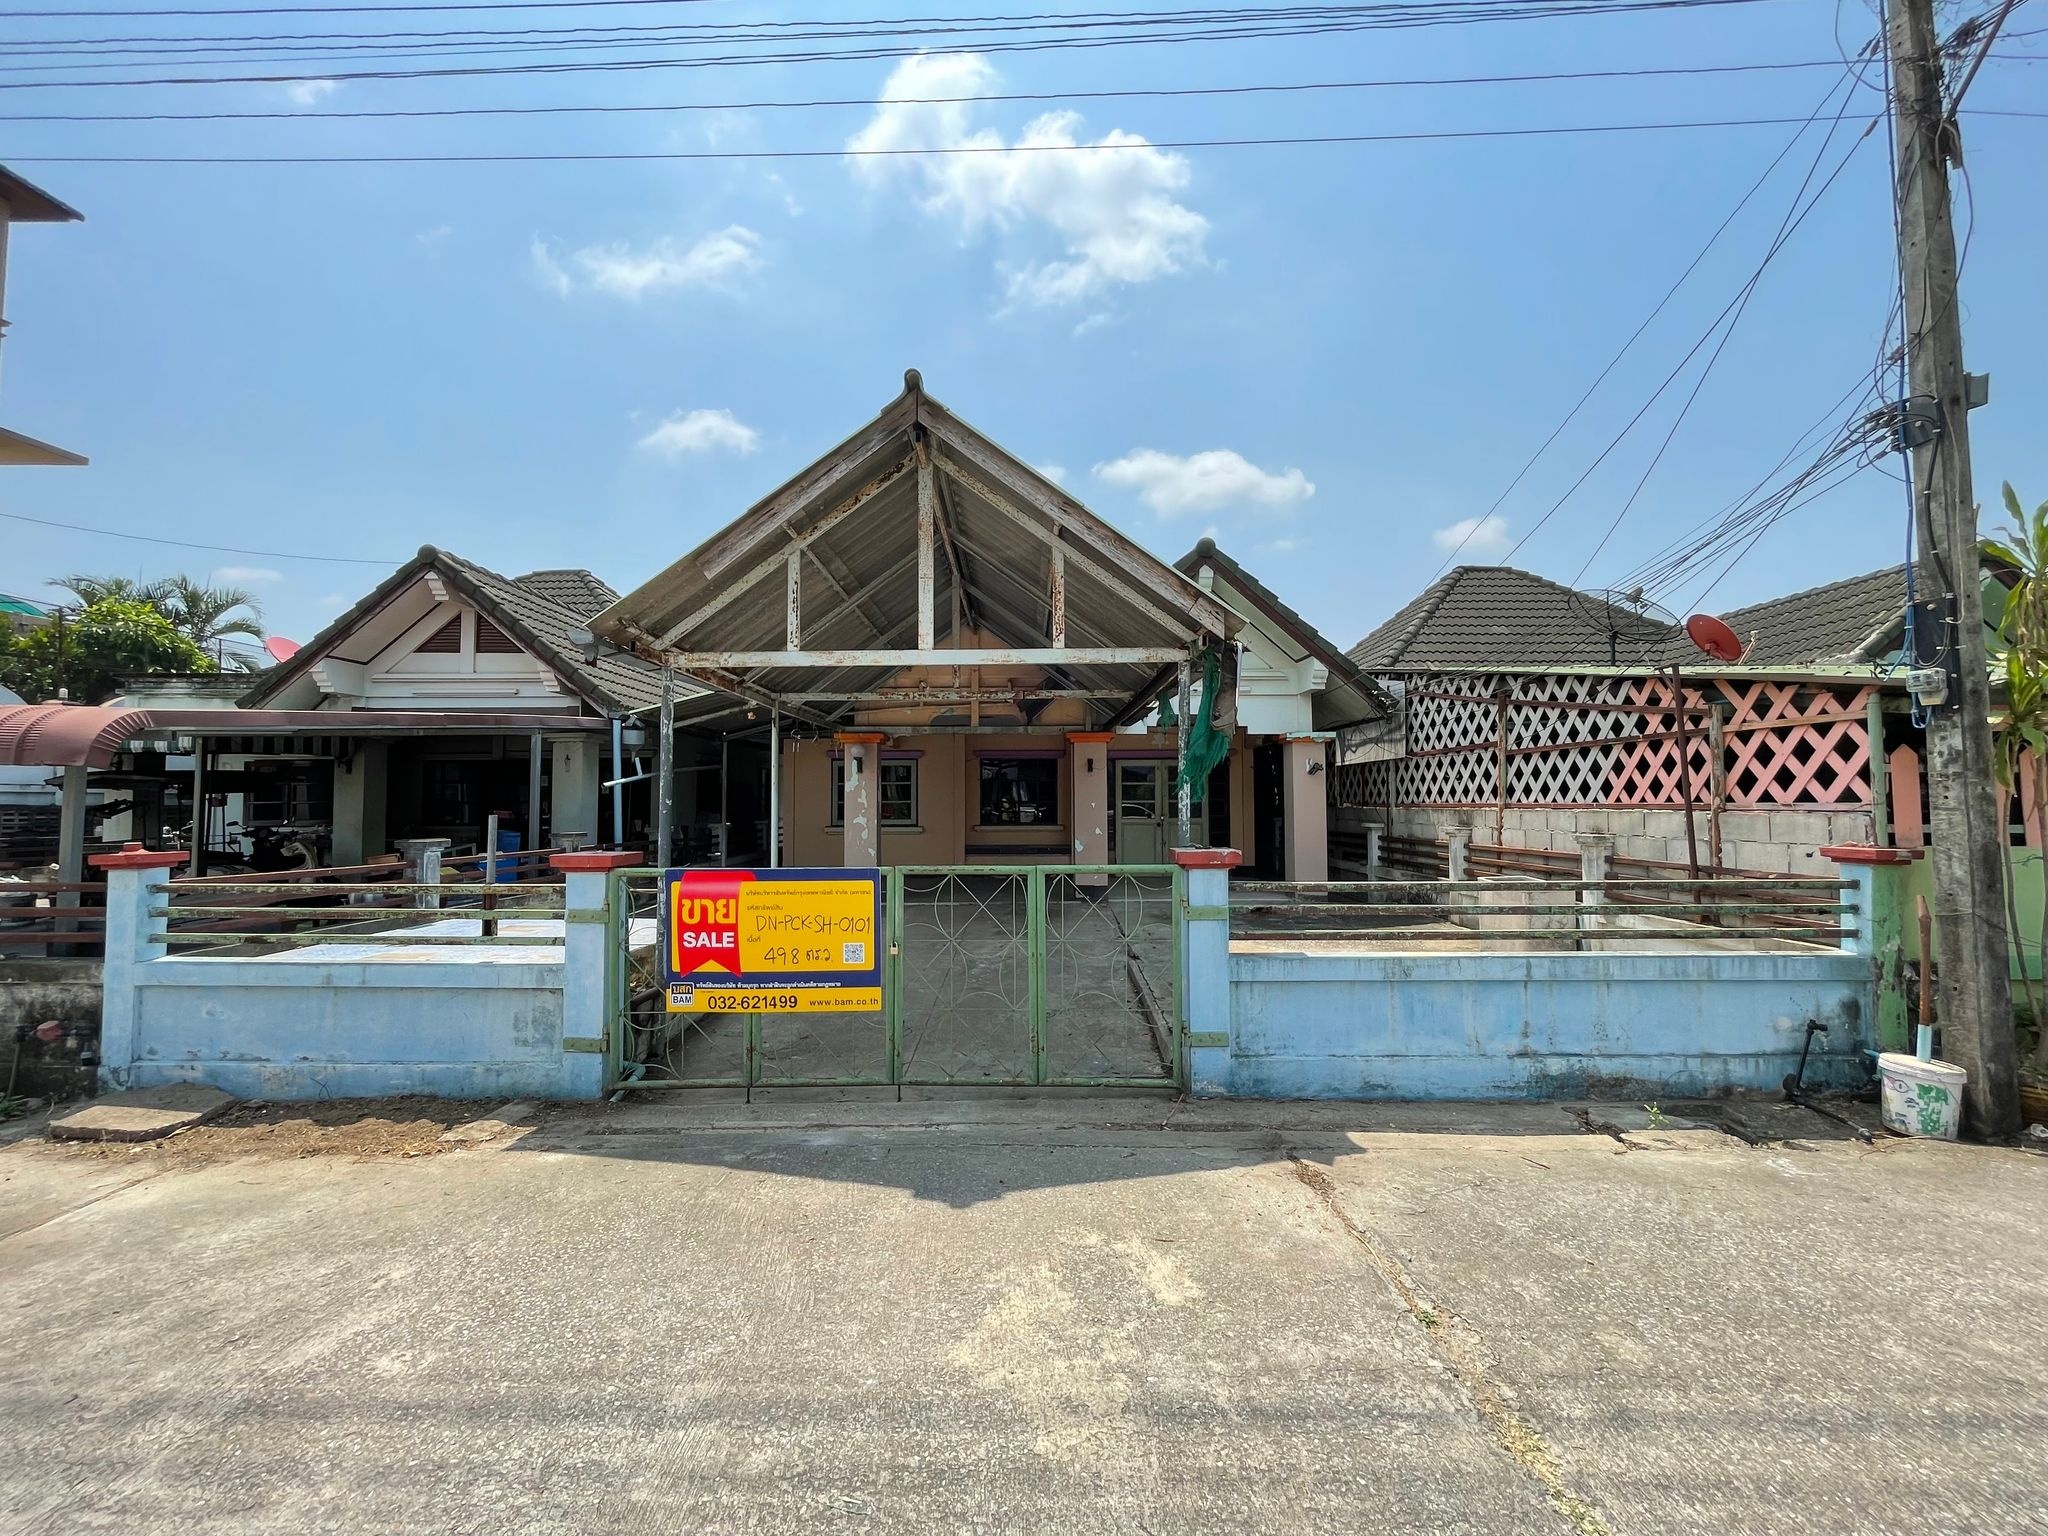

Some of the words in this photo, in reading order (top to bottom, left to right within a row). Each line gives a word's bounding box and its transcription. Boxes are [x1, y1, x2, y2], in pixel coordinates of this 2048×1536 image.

[681, 899, 737, 925] ขาย
[756, 914, 871, 935] DN-PCK-SH-0101
[682, 931, 735, 949] SALE
[672, 984, 692, 994] บสก
[672, 995, 692, 1004] BAM
[707, 995, 798, 1010] 032-621499
[809, 997, 879, 1006] www.bam.co.th
